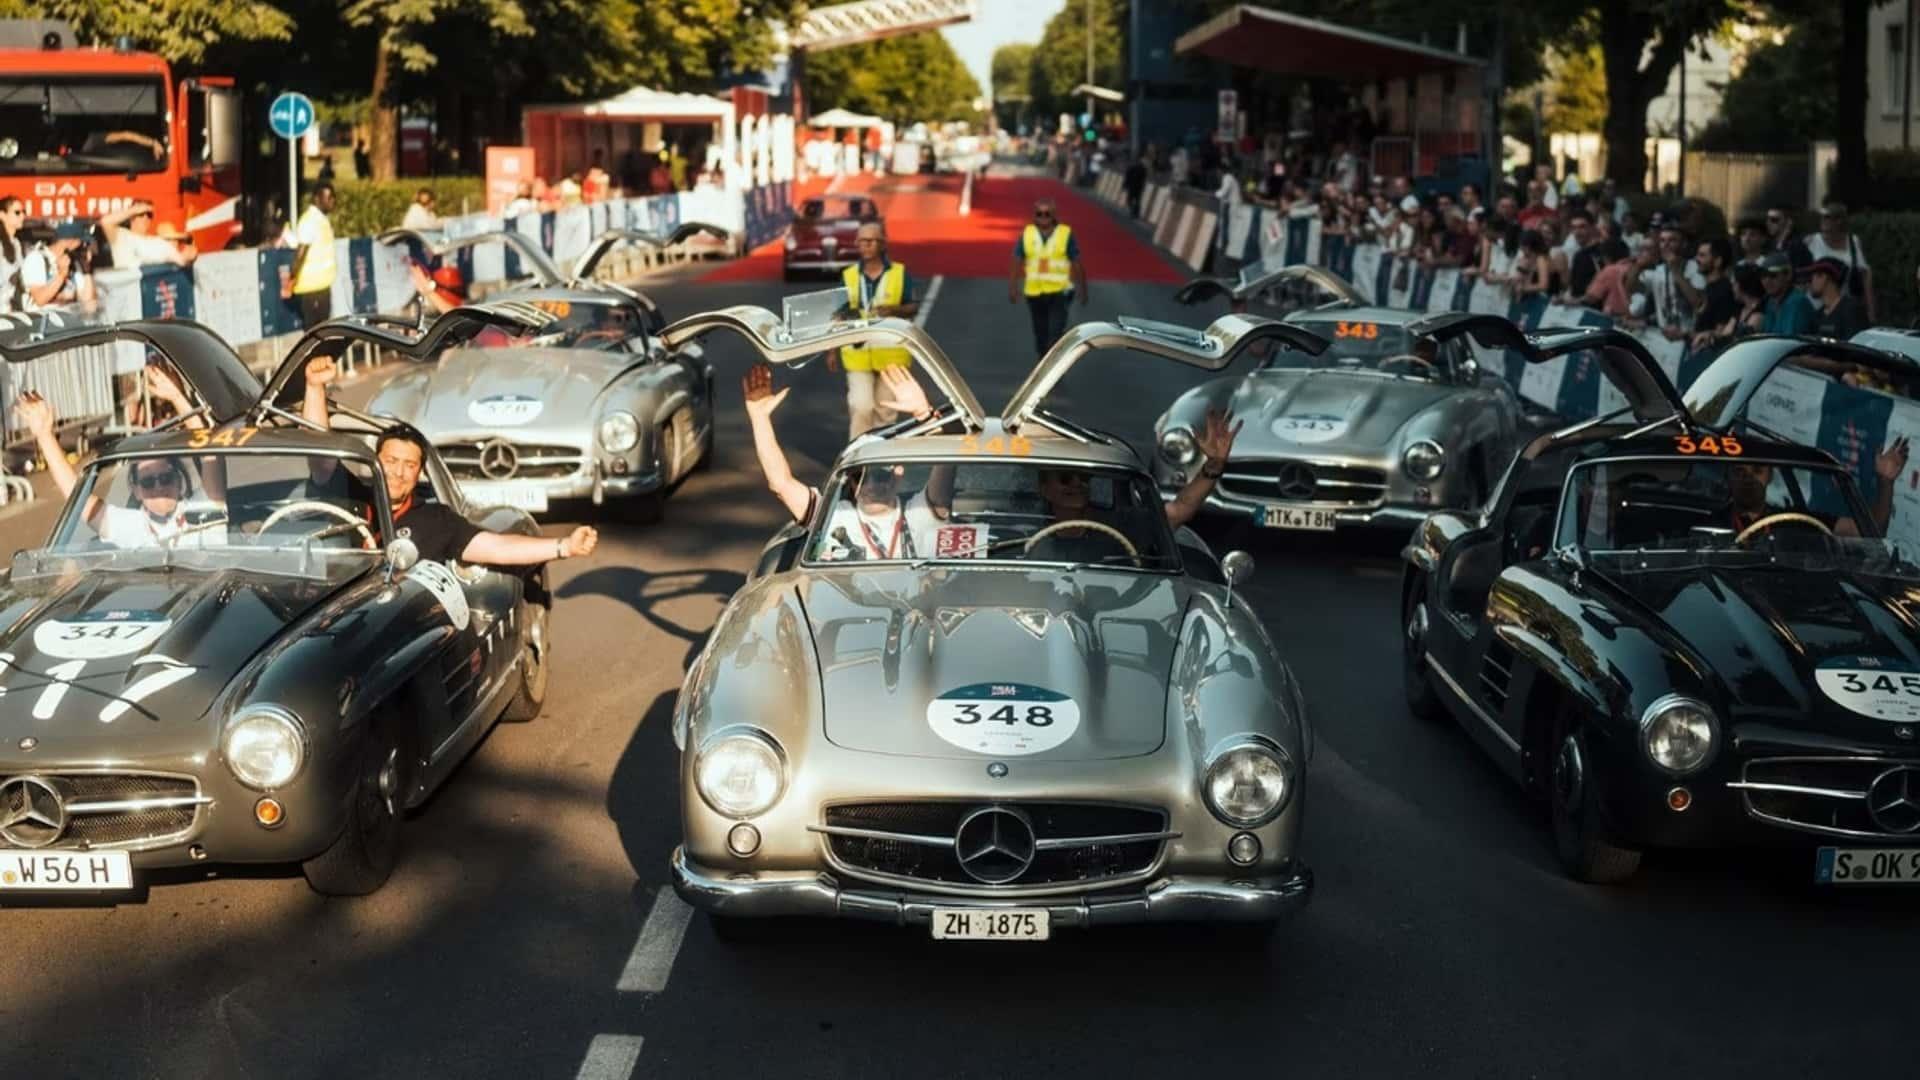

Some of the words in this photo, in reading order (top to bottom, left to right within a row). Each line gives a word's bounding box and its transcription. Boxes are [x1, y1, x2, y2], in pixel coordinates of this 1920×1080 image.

[42, 199, 77, 215] DEL
[1334, 321, 1377, 339] 343
[188, 428, 259, 448] 347
[1674, 436, 1743, 455] 345
[1266, 509, 1292, 525] MTK
[61, 626, 149, 640] 347
[0, 652, 197, 722] 17
[1837, 673, 1920, 696] 345
[953, 704, 1054, 727] 348
[18, 857, 35, 882] W
[44, 857, 80, 883] 56
[89, 857, 109, 883] H
[1835, 853, 1853, 878] S
[1872, 853, 1904, 878] OK
[944, 913, 970, 935] ZH
[986, 914, 1038, 935] 1875
